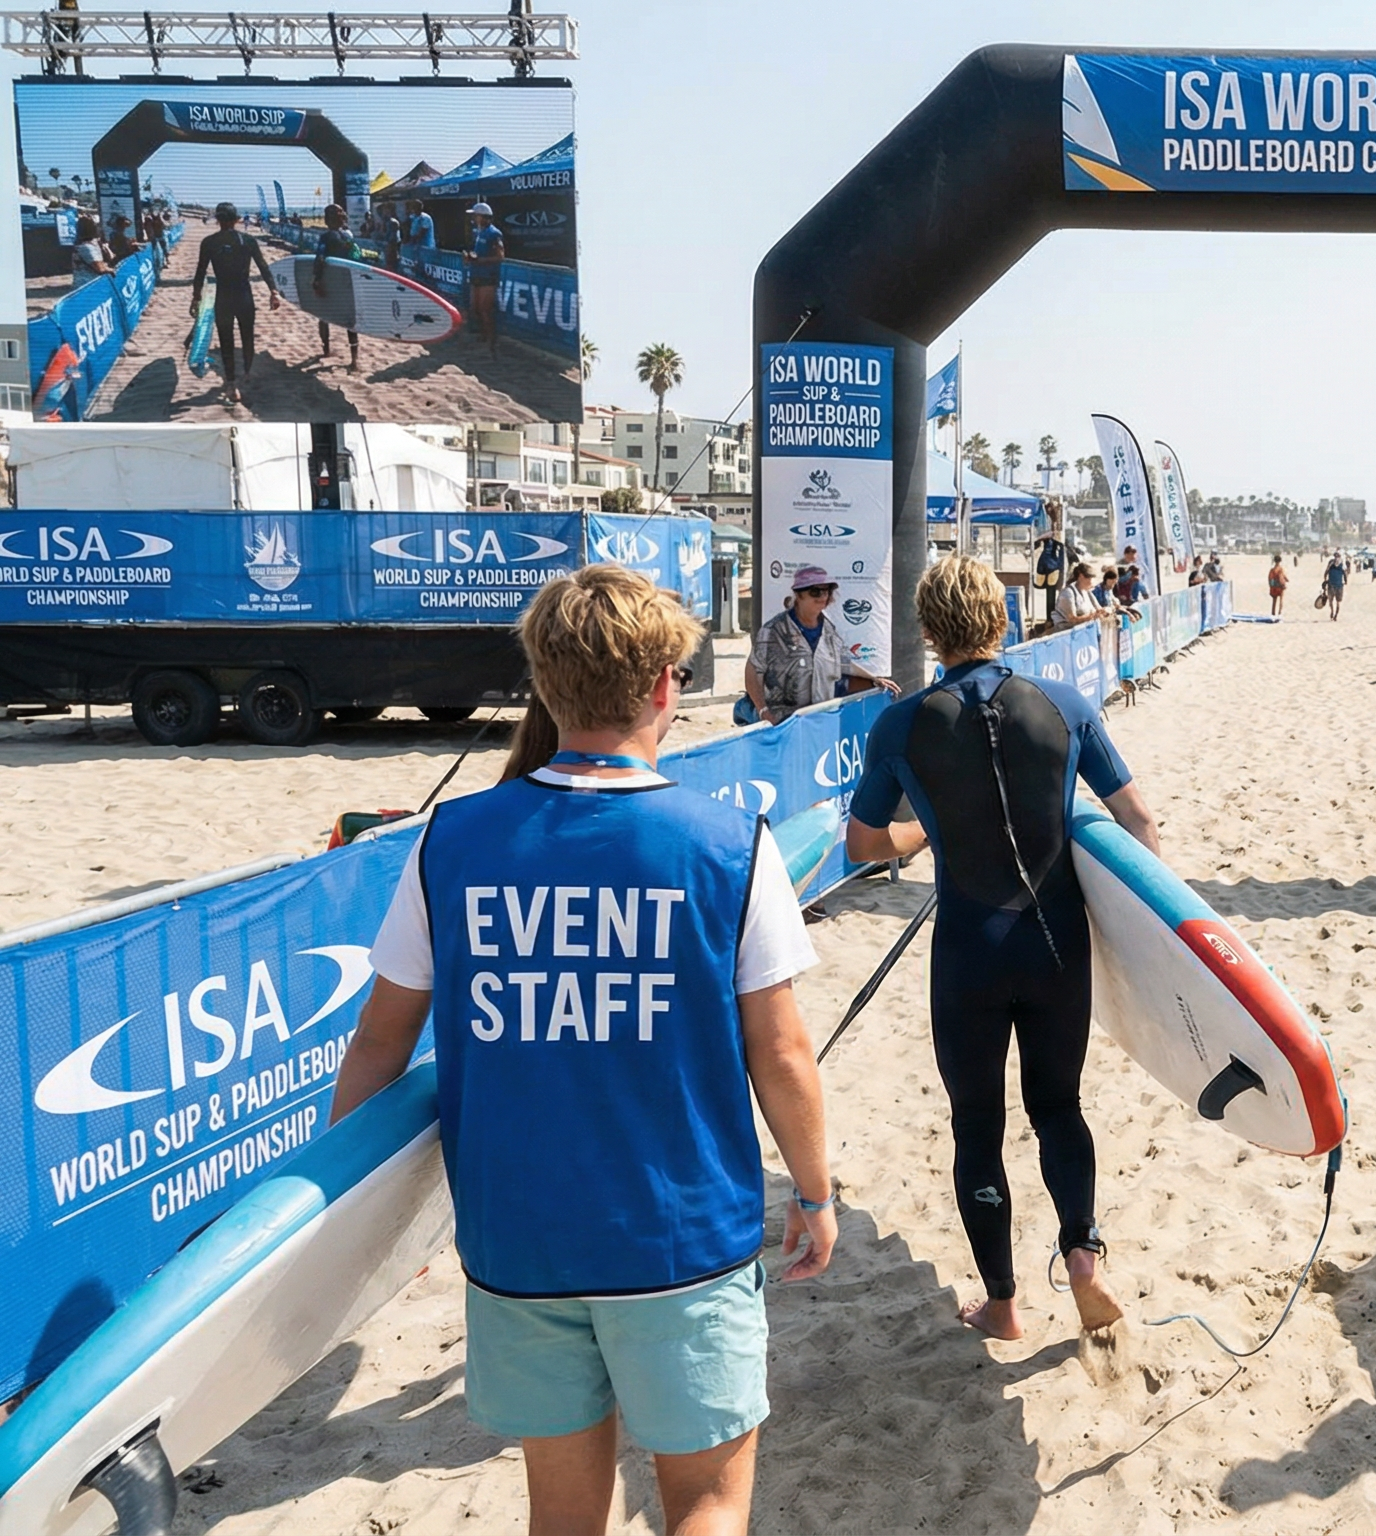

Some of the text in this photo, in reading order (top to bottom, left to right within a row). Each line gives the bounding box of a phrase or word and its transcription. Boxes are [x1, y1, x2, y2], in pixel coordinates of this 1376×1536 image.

[189, 105, 286, 125] ISA WORLD SUP
[1164, 71, 1246, 131] ISA
[1163, 139, 1355, 174] PADDLEBOARD
[770, 355, 881, 387] ISA WORLD
[803, 386, 841, 401] SUP &
[769, 403, 881, 428] PADDLEBOARD
[769, 426, 881, 448] CHAMPIONSHIP
[39, 526, 111, 561] ISA
[435, 529, 506, 564] ISA
[810, 524, 832, 537] ISA
[33, 567, 59, 583] SUP
[63, 568, 73, 583] &
[76, 567, 171, 583] PADDLEBOARD
[373, 569, 420, 585] WORLD
[424, 569, 450, 585] SUP
[455, 569, 464, 584] &
[27, 589, 129, 605] CHAMPIONSHIP
[420, 591, 523, 607] CHAMPIONSHIP
[835, 737, 864, 785] ISA
[465, 886, 685, 958] EVENT
[470, 971, 675, 1042] STAFF
[164, 959, 291, 1091] ISA
[50, 1128, 147, 1206] WORLD
[155, 1109, 203, 1158] SUP
[209, 1093, 226, 1131] &
[151, 1105, 318, 1223] CHAMPIONSHIP
